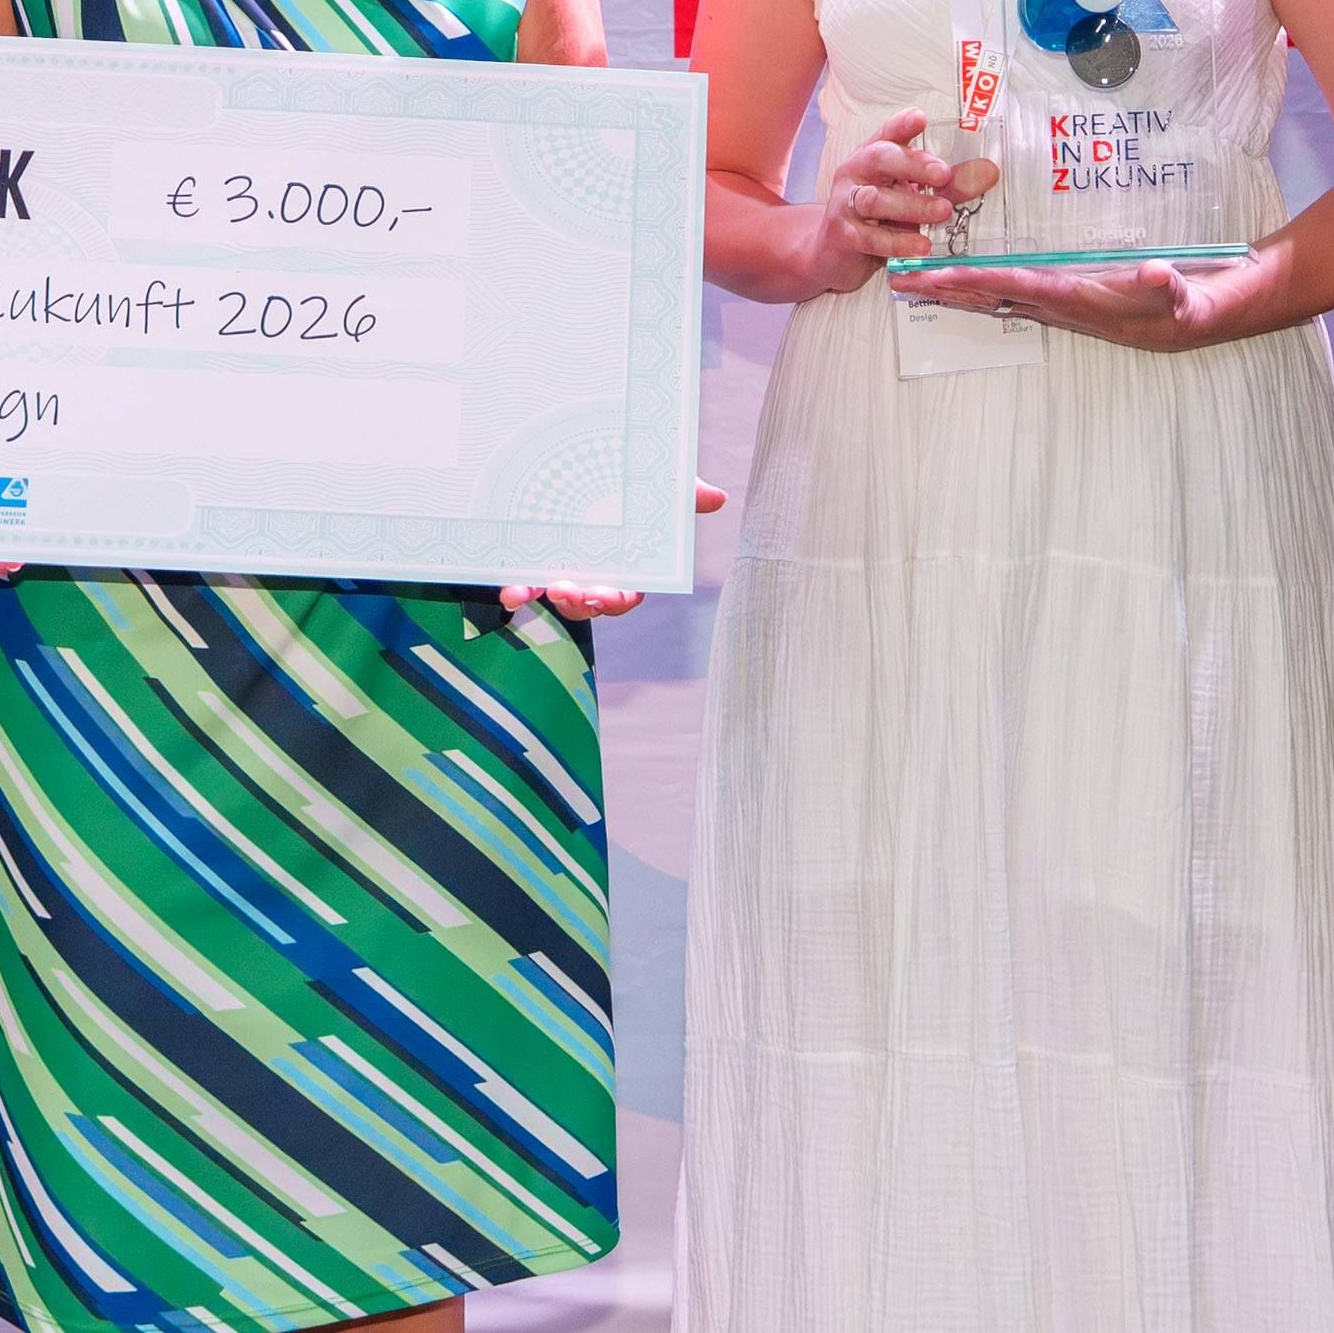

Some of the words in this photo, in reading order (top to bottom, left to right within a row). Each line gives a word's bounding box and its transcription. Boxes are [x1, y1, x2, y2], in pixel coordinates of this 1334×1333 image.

[1149, 34, 1185, 51] 2026
[1050, 110, 1173, 138] KREATIV
[1052, 140, 1082, 165] IN
[1093, 138, 1141, 163] DIE
[1052, 162, 1195, 192] ZUKUNFT
[166, 175, 200, 218] €
[217, 291, 377, 343] 2026
